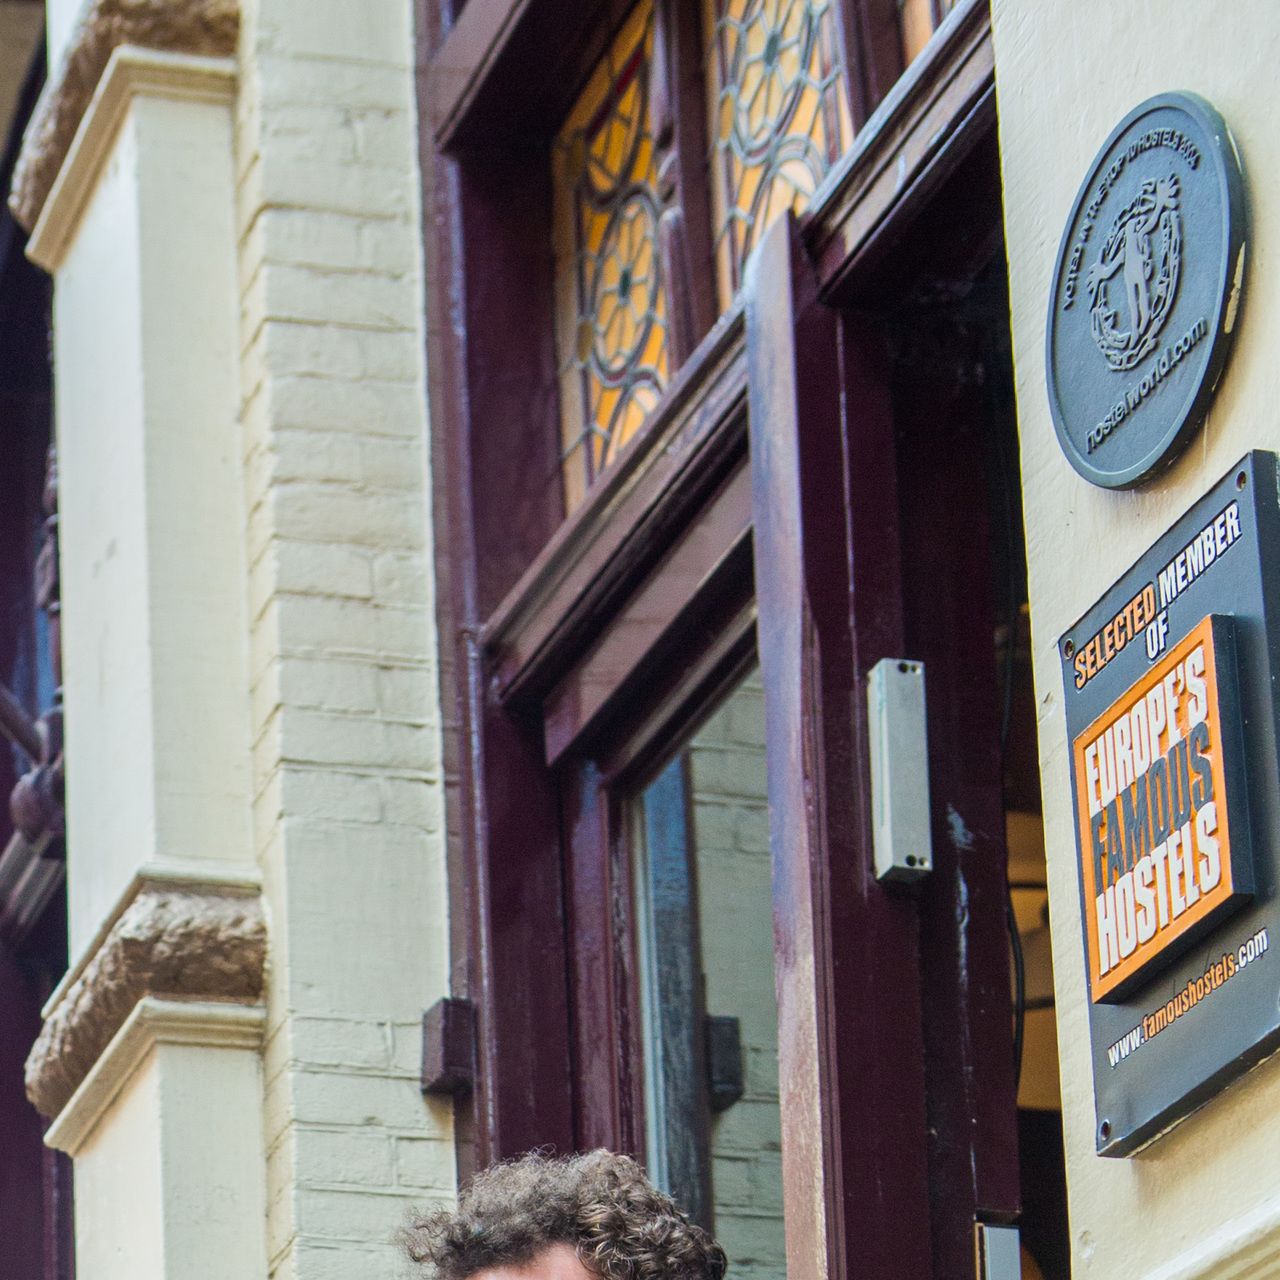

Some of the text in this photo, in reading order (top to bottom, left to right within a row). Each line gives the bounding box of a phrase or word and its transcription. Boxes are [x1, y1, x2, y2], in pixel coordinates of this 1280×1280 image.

[1085, 316, 1208, 455] hostelworld.com
[1075, 501, 1242, 689] SELECTED MEMBER
[1146, 611, 1169, 660] OF
[1085, 646, 1208, 814] EUROPE'S
[1091, 721, 1213, 896] FAMOUS
[1096, 802, 1220, 976] HOSTELS
[1108, 927, 1269, 1068] www.famoushostels.com
